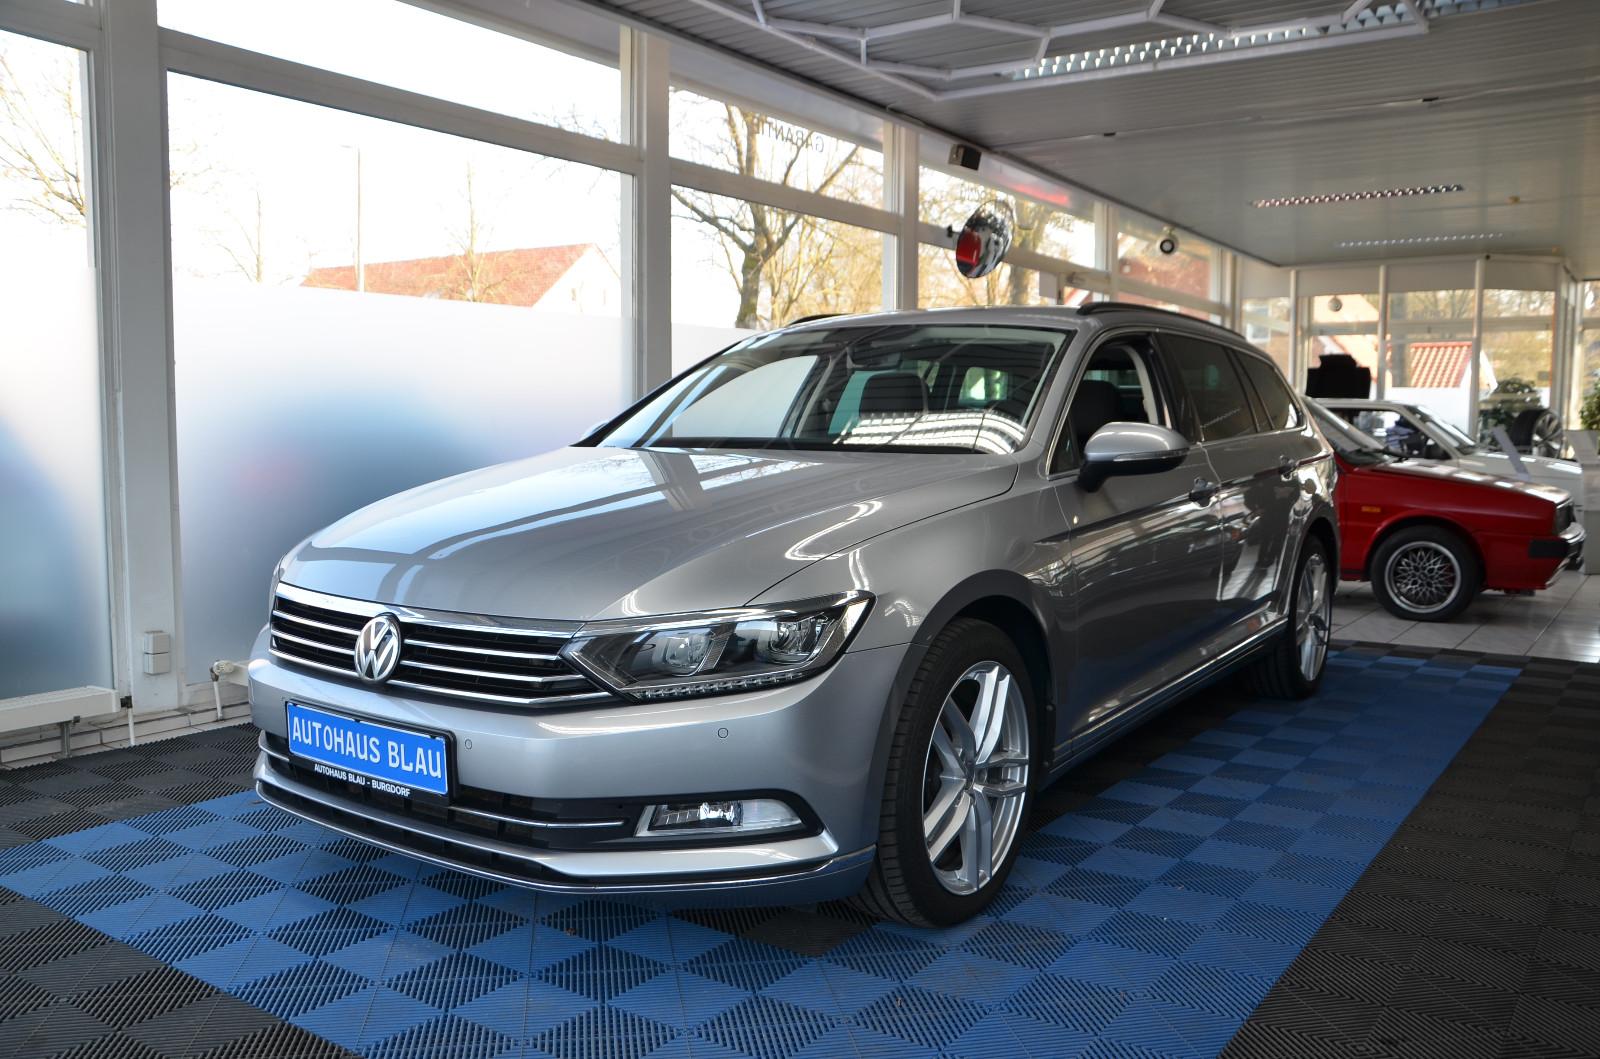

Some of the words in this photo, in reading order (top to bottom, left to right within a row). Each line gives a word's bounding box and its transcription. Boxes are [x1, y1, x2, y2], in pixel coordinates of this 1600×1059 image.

[292, 716, 381, 764] AUTOHAUS
[387, 740, 442, 779] BLAU
[314, 763, 347, 781] AUTOHAUS
[347, 773, 366, 786] BLAU
[371, 779, 411, 797] BURGDORF
